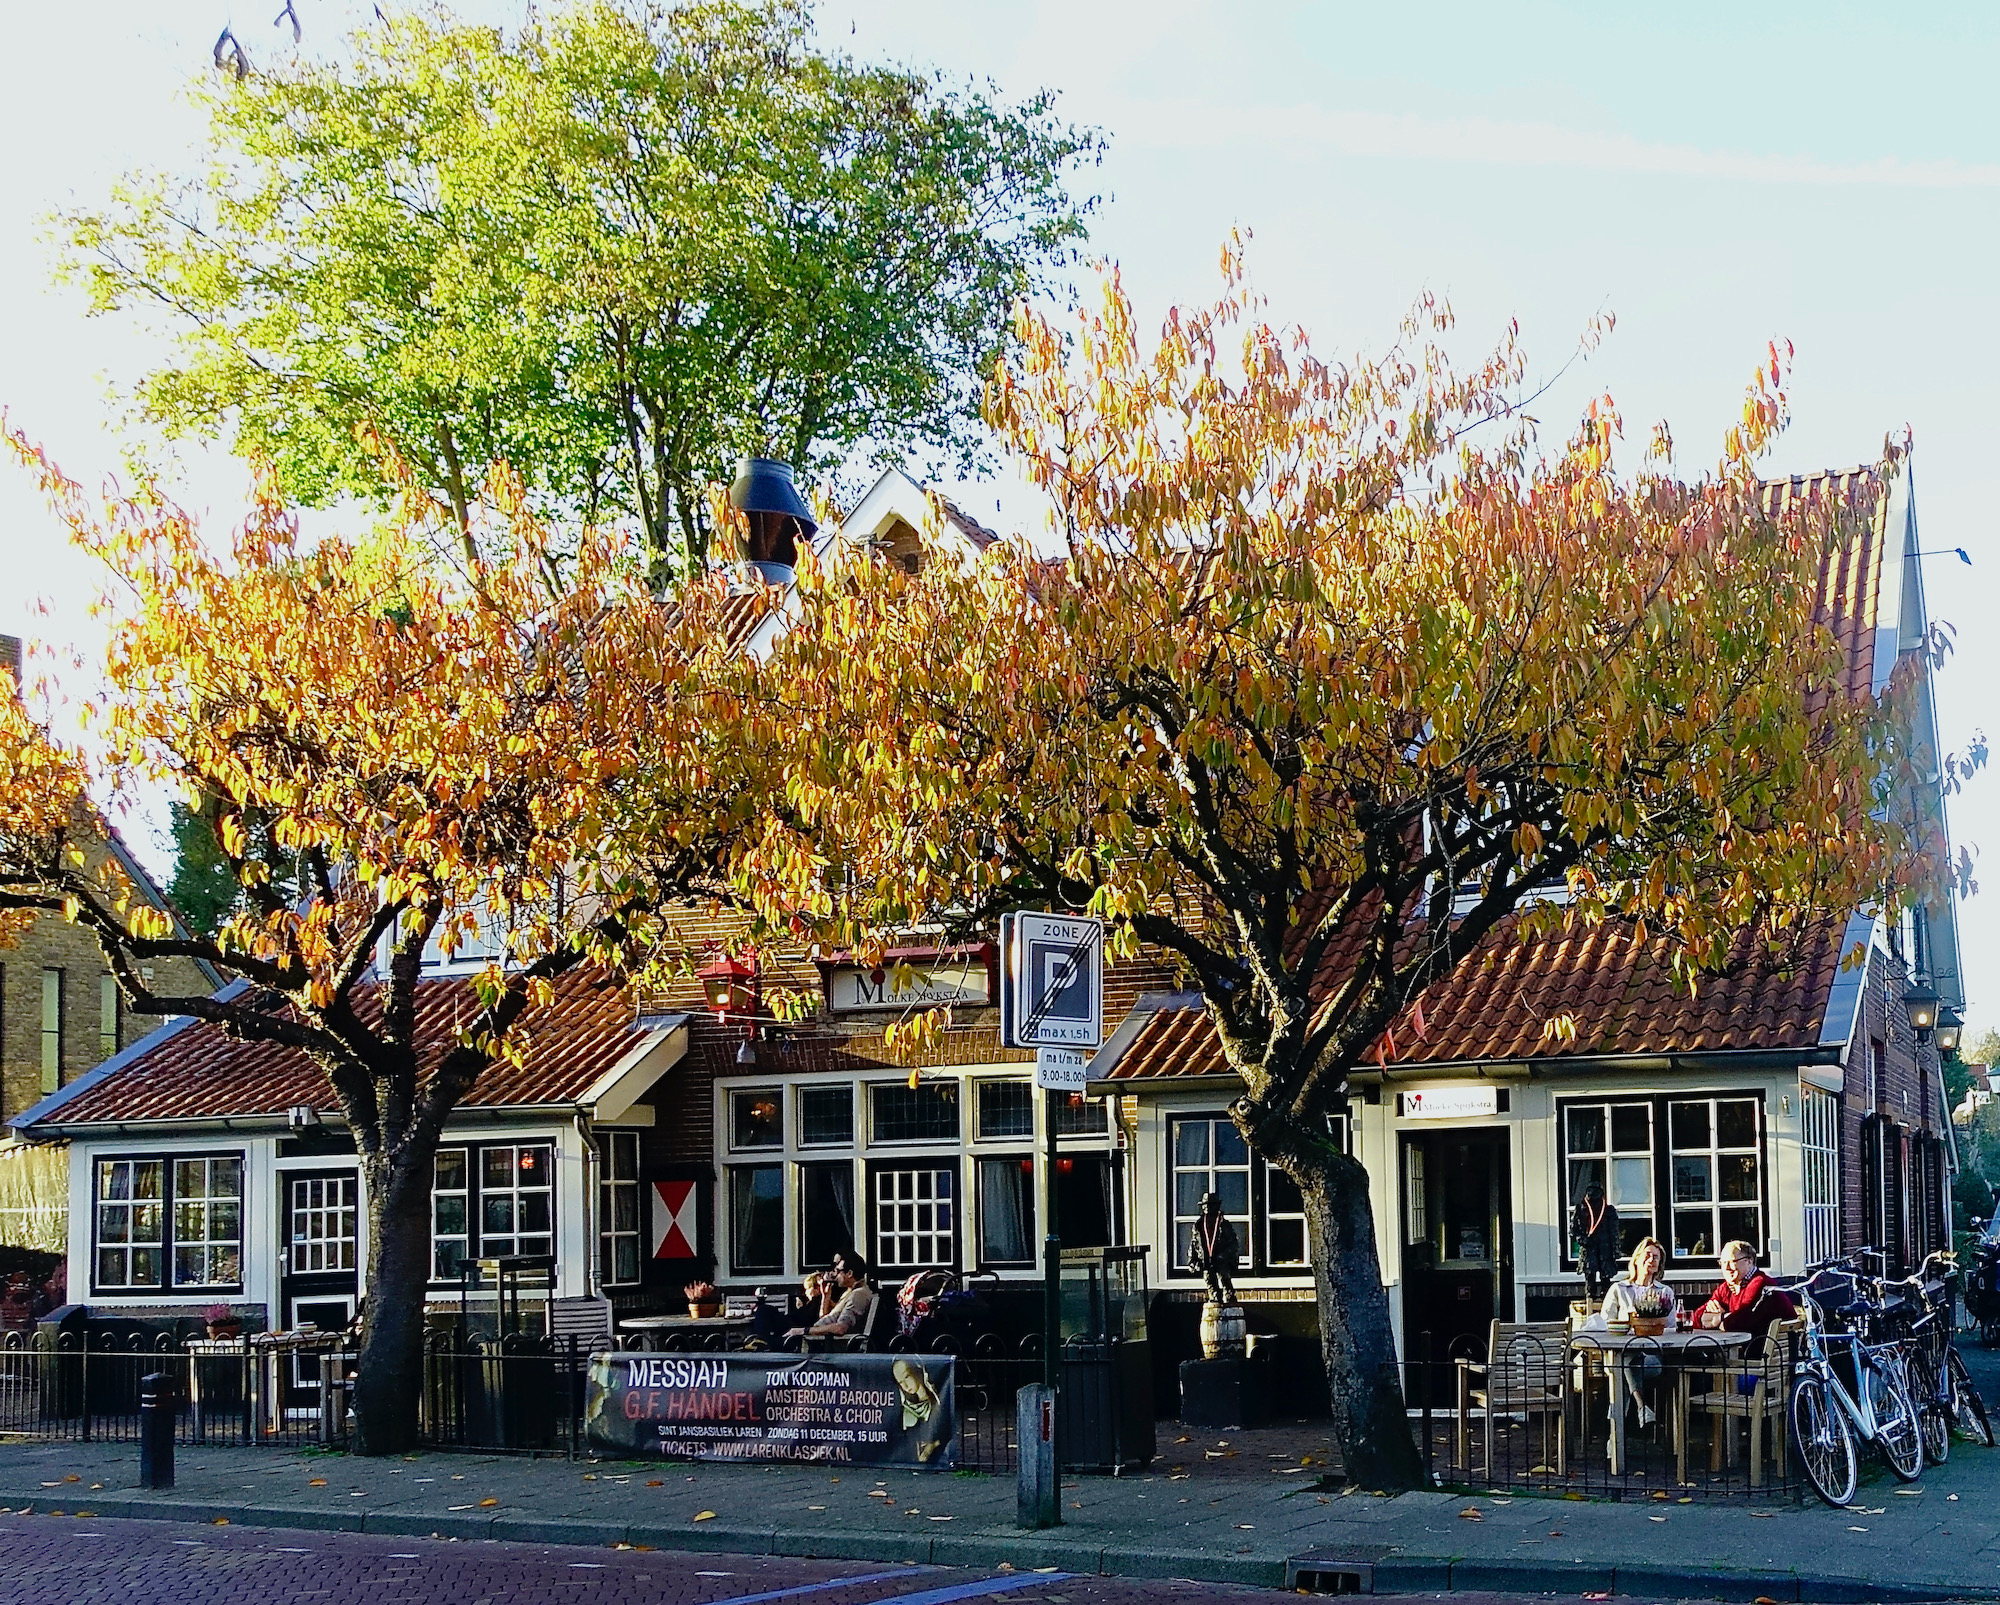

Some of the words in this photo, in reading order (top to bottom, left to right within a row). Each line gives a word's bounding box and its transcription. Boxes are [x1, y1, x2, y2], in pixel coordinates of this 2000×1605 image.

[1044, 925, 1079, 938] ZONE
[1041, 1028, 1067, 1038] max
[1071, 1028, 1090, 1040] 1.5h
[1046, 1054, 1056, 1063] ma
[1059, 1052, 1072, 1064] t/m
[1074, 1056, 1082, 1065] za
[628, 1360, 728, 1388] MESSIAH
[766, 1371, 788, 1386] TON
[792, 1371, 850, 1387] KOOPMAN
[624, 1390, 661, 1420] G.F.
[668, 1387, 761, 1421] HÄNDEL
[765, 1389, 836, 1405] AMSTERDAM
[839, 1391, 895, 1408] BAROQUE
[766, 1407, 831, 1422] ORCHESTRA
[833, 1408, 843, 1423] &
[846, 1409, 883, 1424] CHOIR
[658, 1425, 677, 1437] SINT
[735, 1427, 762, 1438] LAREN
[767, 1427, 799, 1440] ZONDAG
[800, 1428, 808, 1440] 11
[810, 1429, 856, 1442] DECEMBER,
[857, 1430, 867, 1442] 15
[868, 1431, 888, 1442] UUR
[660, 1441, 707, 1456] TICKETS
[712, 1441, 852, 1461] WWW.LARENKLASSIEK.NL
